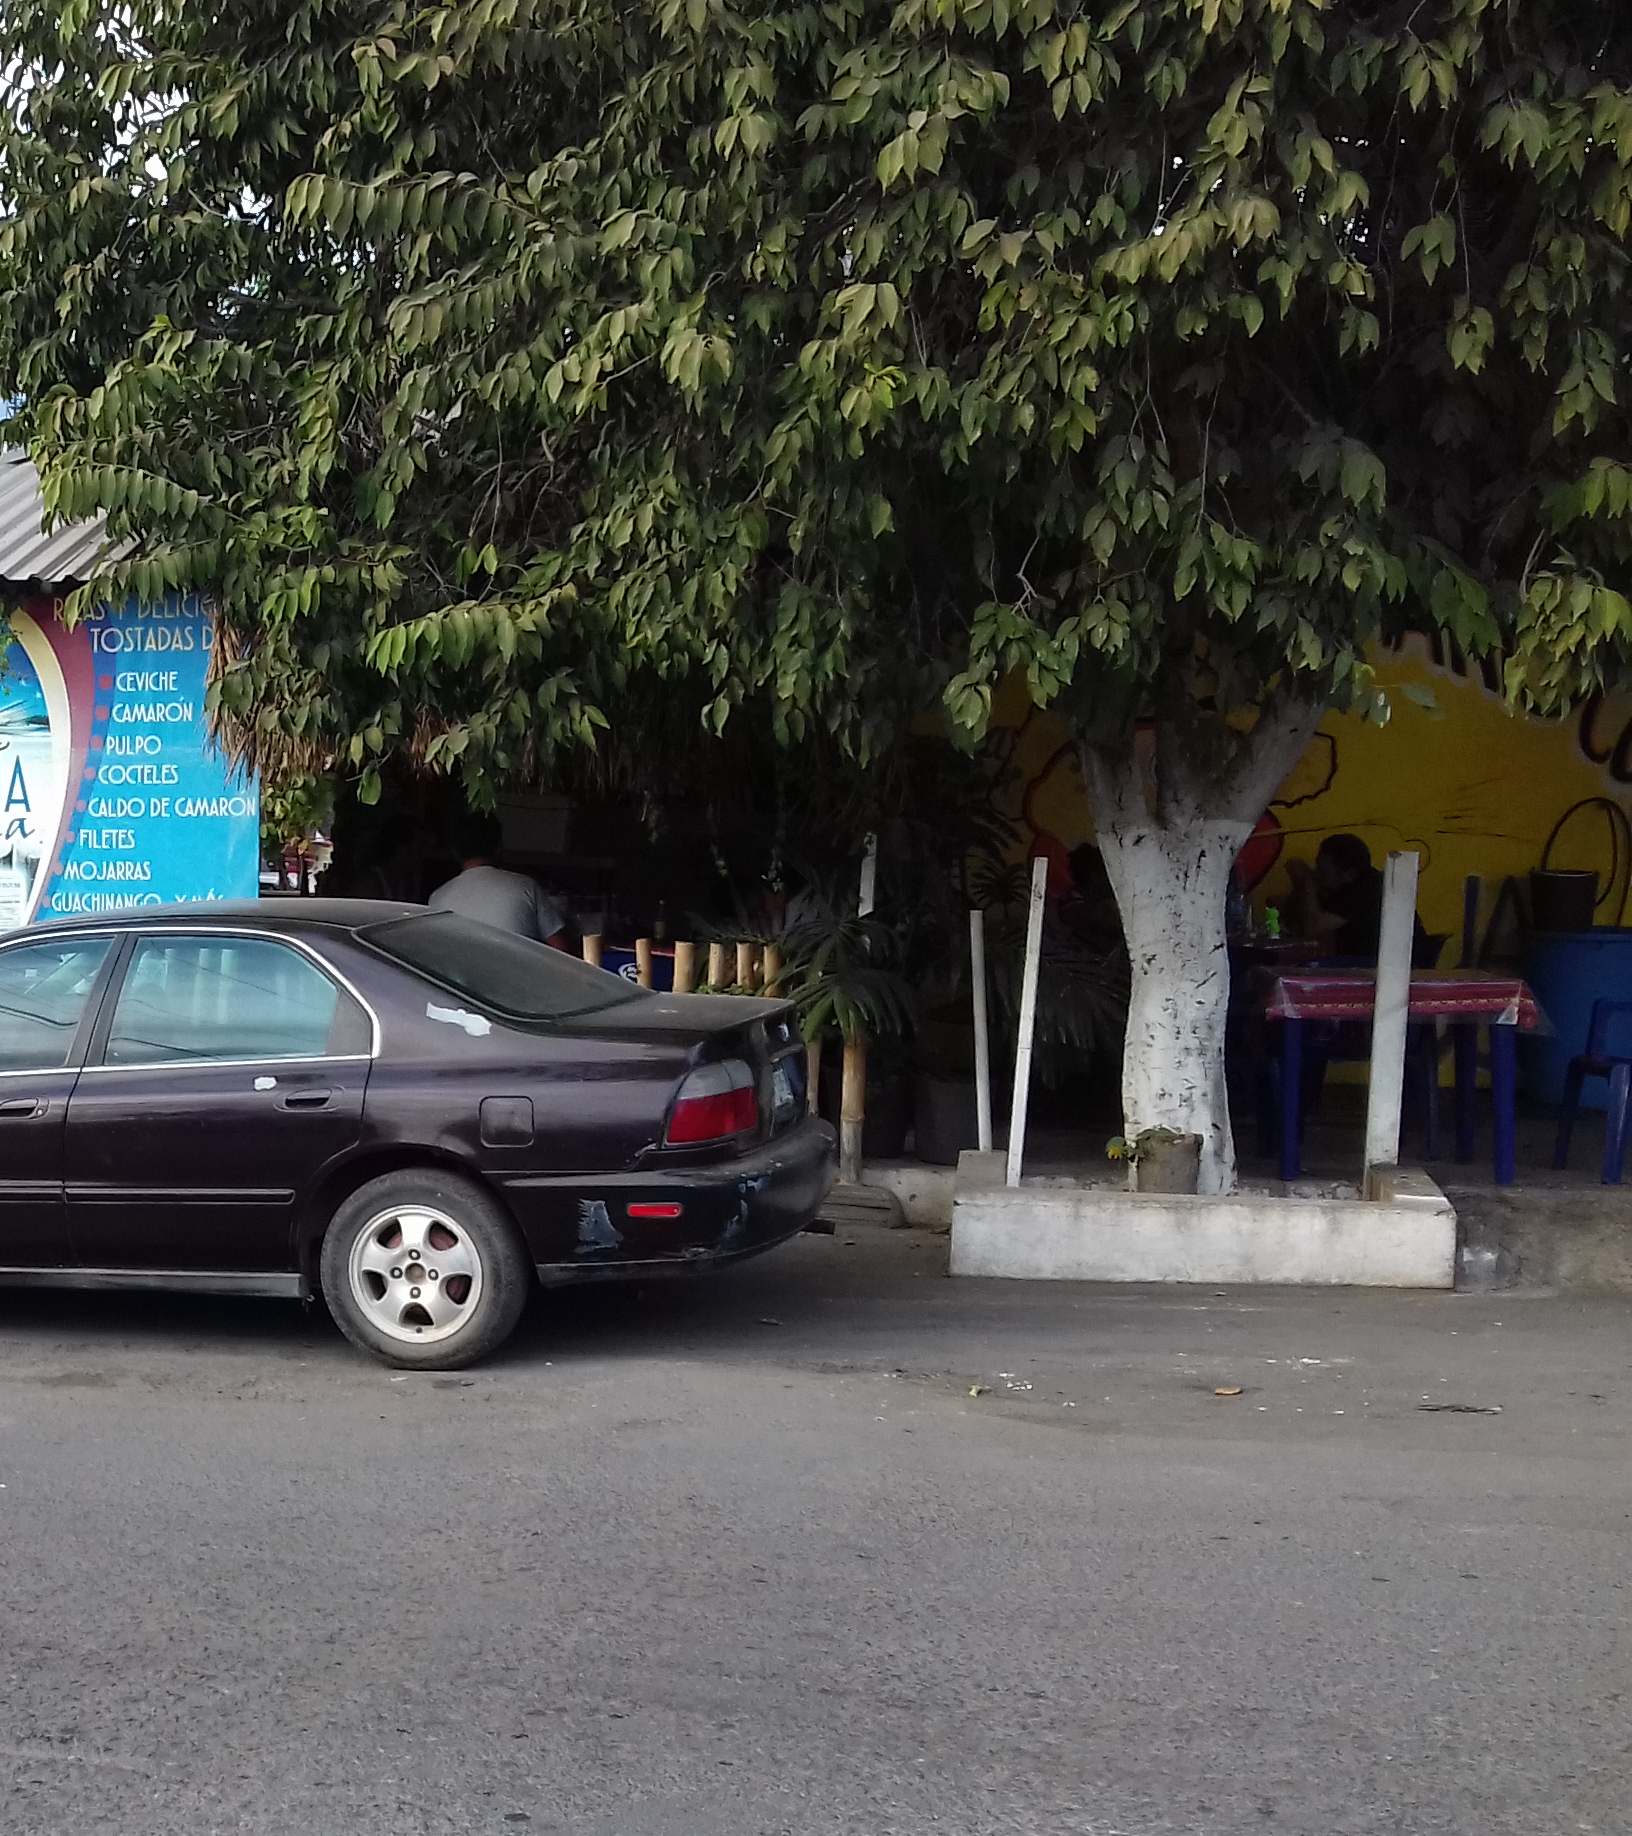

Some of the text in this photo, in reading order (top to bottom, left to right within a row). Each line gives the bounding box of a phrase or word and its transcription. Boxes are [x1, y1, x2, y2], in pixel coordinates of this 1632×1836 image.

[90, 626, 195, 654] TOSTADAS
[116, 671, 179, 692] CEVICHE
[112, 696, 193, 723] CAMARÓN
[106, 735, 162, 755] PULPO
[98, 764, 179, 785] COCTELES
[88, 797, 146, 818] CALDO
[150, 797, 171, 818] DE
[79, 829, 136, 849] FILETES
[63, 861, 152, 881] MOJARRAS
